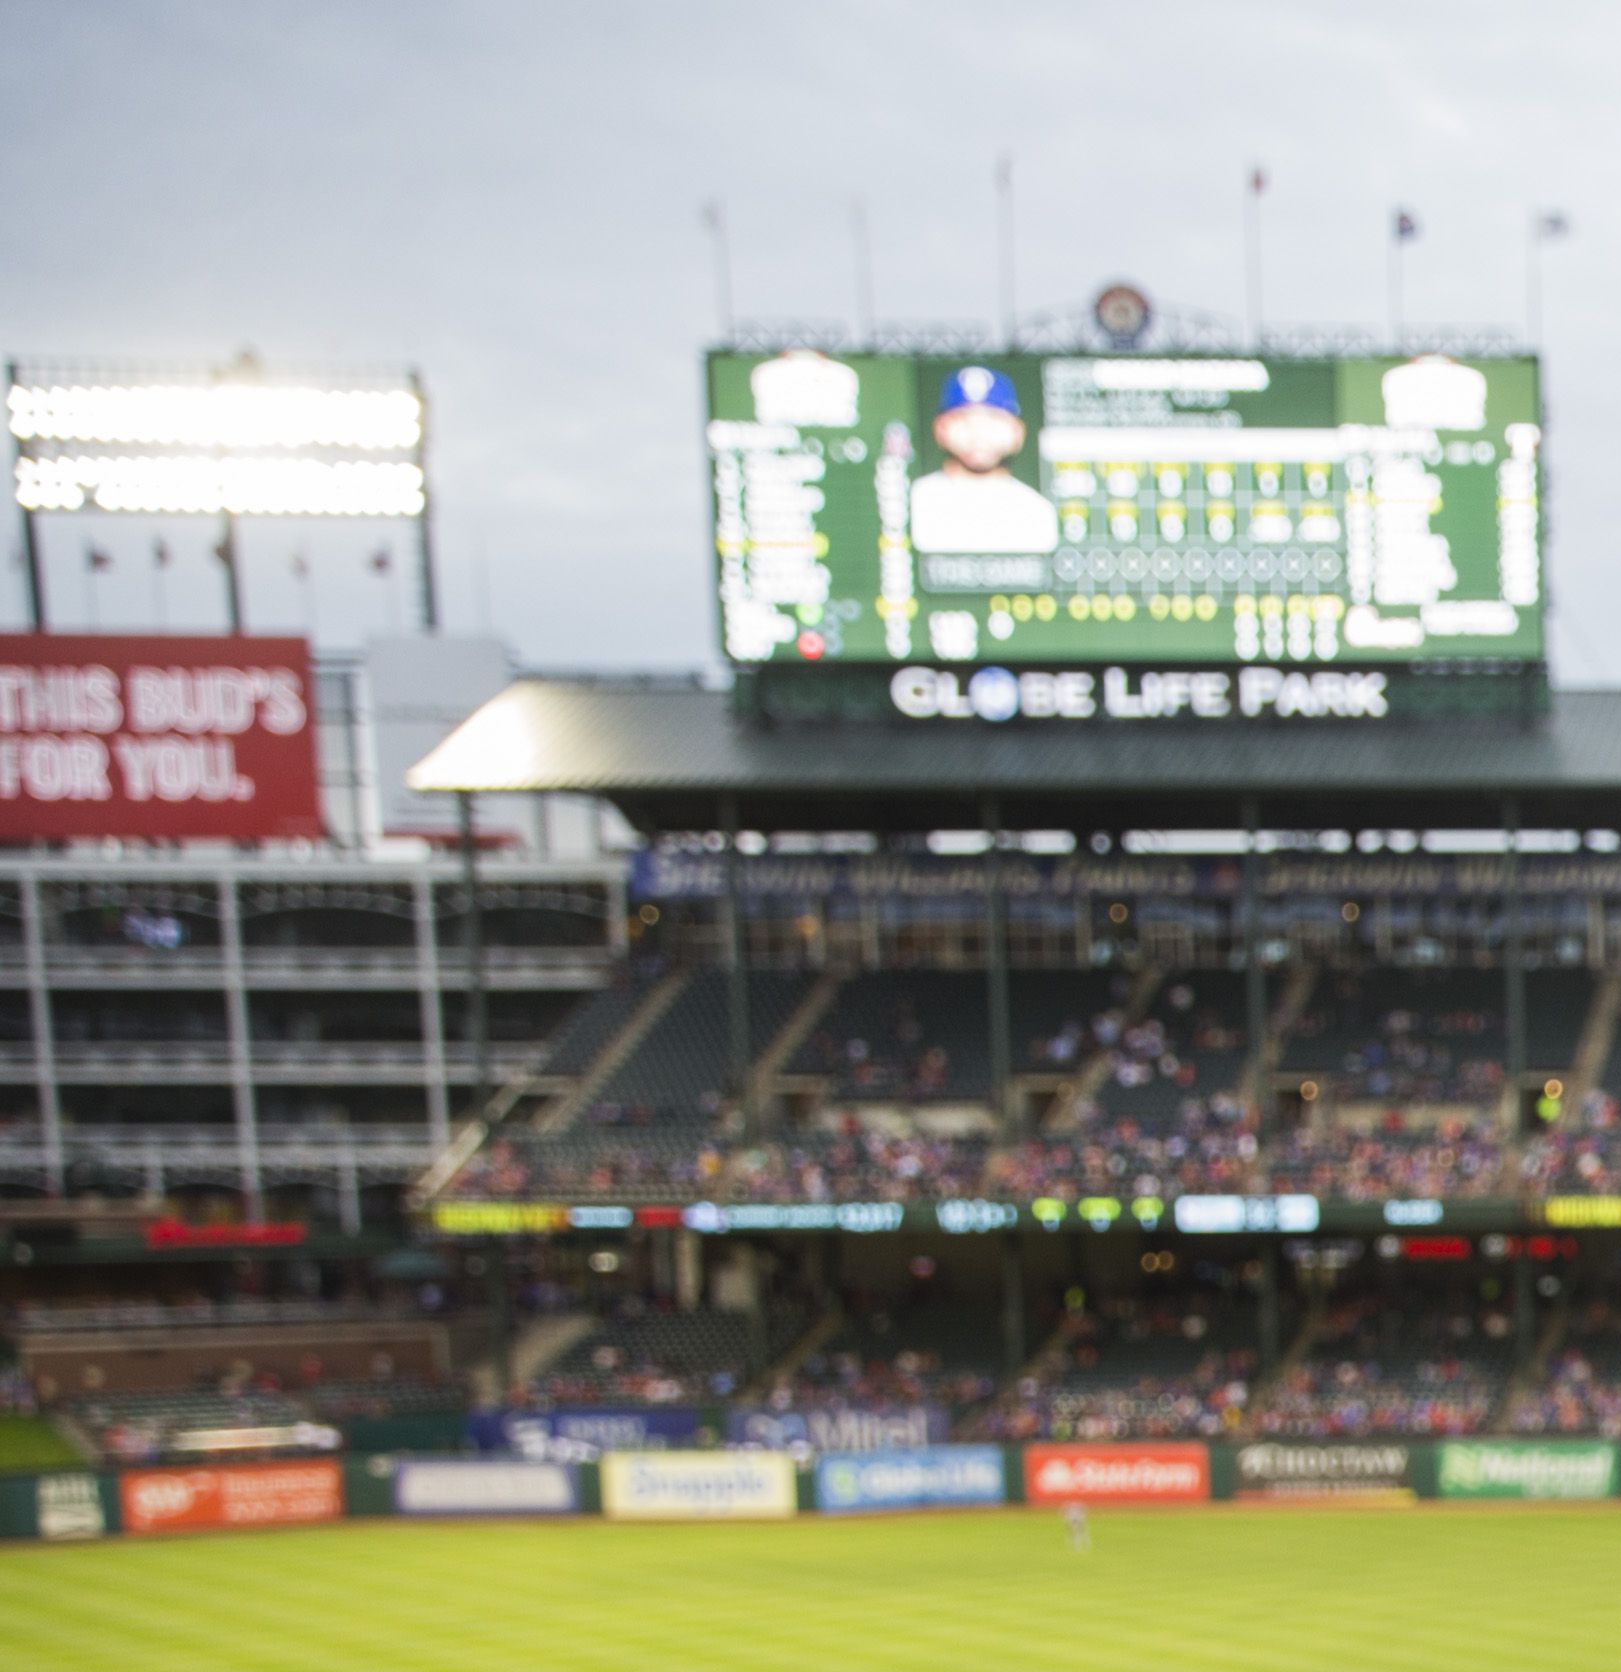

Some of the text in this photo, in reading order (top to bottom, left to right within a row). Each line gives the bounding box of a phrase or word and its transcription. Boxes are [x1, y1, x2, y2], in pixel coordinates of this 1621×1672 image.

[0, 664, 307, 736] THIS BUD'S
[890, 665, 1388, 721] GLOBE LIFE PARK
[0, 731, 113, 802] FOR
